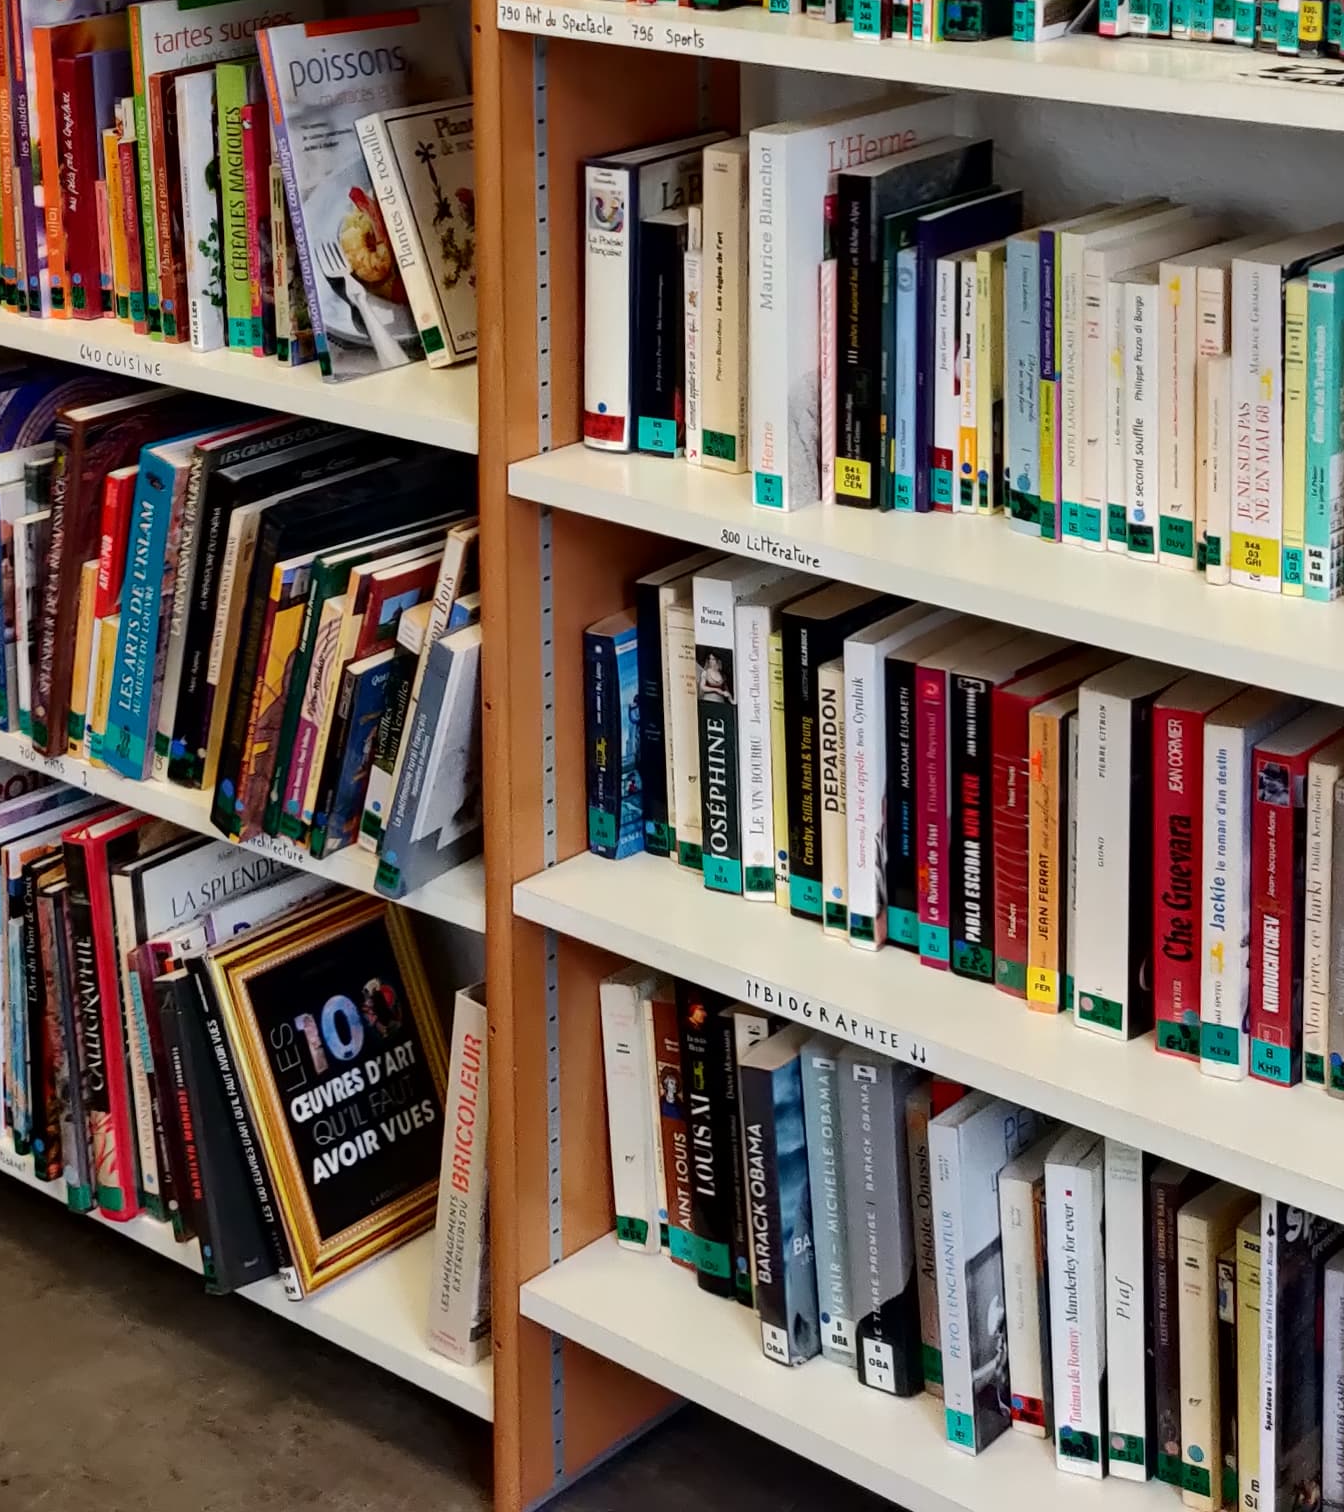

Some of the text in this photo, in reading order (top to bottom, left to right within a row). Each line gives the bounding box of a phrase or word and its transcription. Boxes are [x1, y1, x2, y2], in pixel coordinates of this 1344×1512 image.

[154, 9, 297, 56] tartes sucrées
[525, 7, 543, 25] Art
[562, 15, 613, 36] Spectacle
[631, 24, 654, 43] 796
[666, 28, 705, 49] Sports
[288, 44, 405, 91] poissons
[226, 106, 242, 197] MAGIQUES
[828, 126, 917, 173] L'Herne
[362, 122, 417, 272] Plantes de rocaille
[760, 227, 773, 311] Maurice
[80, 343, 162, 378] 640 CUISINE
[761, 420, 775, 470] Herne
[720, 531, 820, 570] 800 Littérature
[120, 500, 155, 712] LES ARTS DE L'ISLAM
[702, 606, 723, 617] Pierre
[821, 688, 839, 812] DEPARDON
[1168, 718, 1184, 762] CORMIER
[707, 717, 728, 861] JOSÉPHINE
[963, 803, 980, 837] MON
[1217, 818, 1228, 856] roman
[964, 841, 981, 890] ESCOBAR
[1160, 813, 1193, 963] Che Guevara
[964, 893, 981, 943] PABLO
[1210, 876, 1228, 932] Jackie
[290, 1040, 417, 1122] ŒUVRES D'ART
[1258, 1062, 1282, 1077] KHR
[312, 1109, 368, 1145] QU'IL
[451, 1034, 483, 1193] BRICOLEUR
[312, 1099, 436, 1184] AVOIR VUES
[695, 1094, 716, 1196] LOUIS XI
[748, 1123, 772, 1285] BARACK OBAMA
[1115, 1275, 1135, 1321] Piaf
